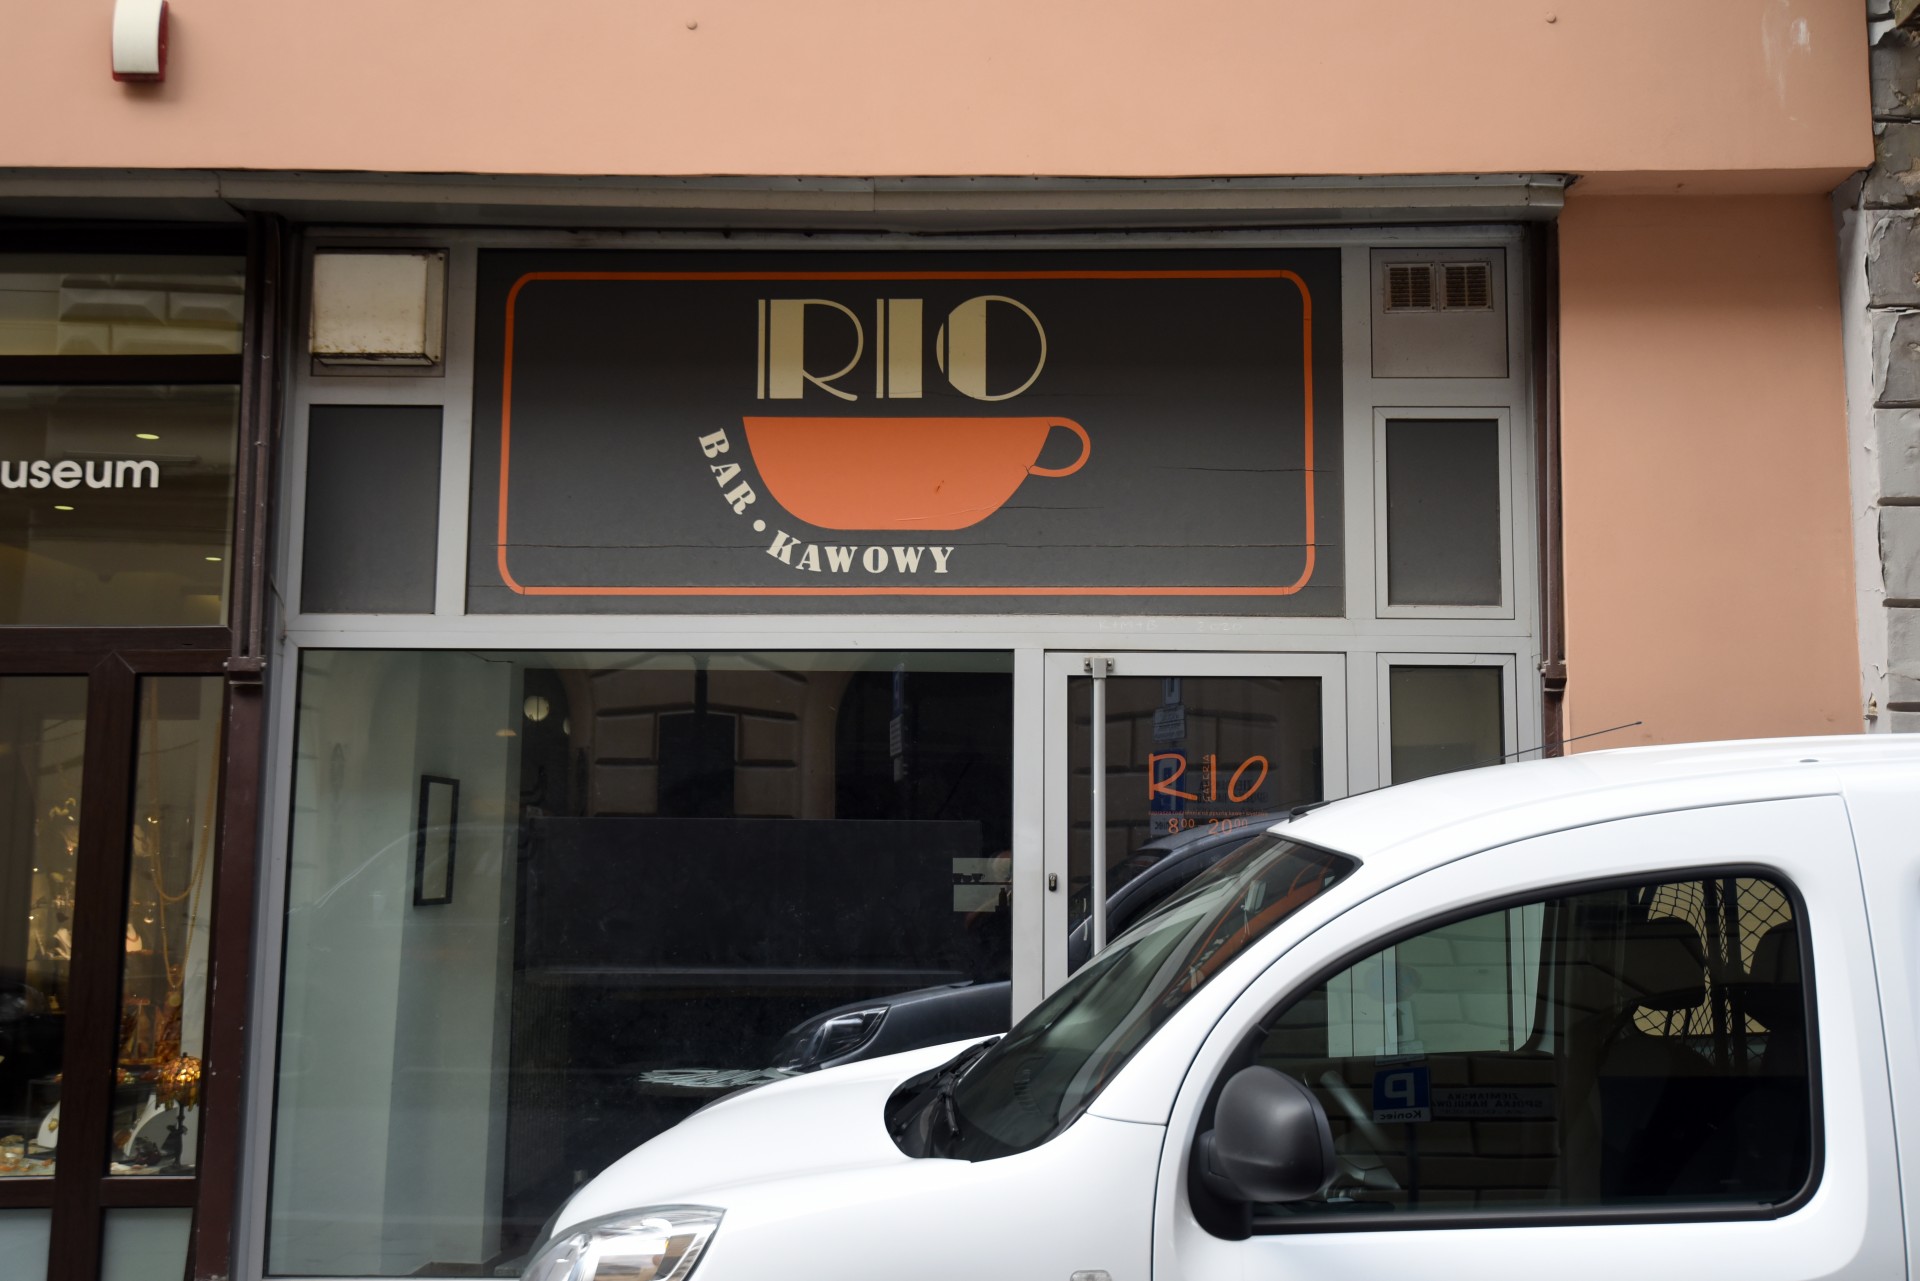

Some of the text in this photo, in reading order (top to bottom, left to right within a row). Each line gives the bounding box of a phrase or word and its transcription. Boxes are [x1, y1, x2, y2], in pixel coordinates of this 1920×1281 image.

[757, 295, 1047, 401] RIO
[699, 428, 955, 574] BAR KAWOWY
[1149, 753, 1269, 803] RIO
[1202, 754, 1212, 803] GALERIA
